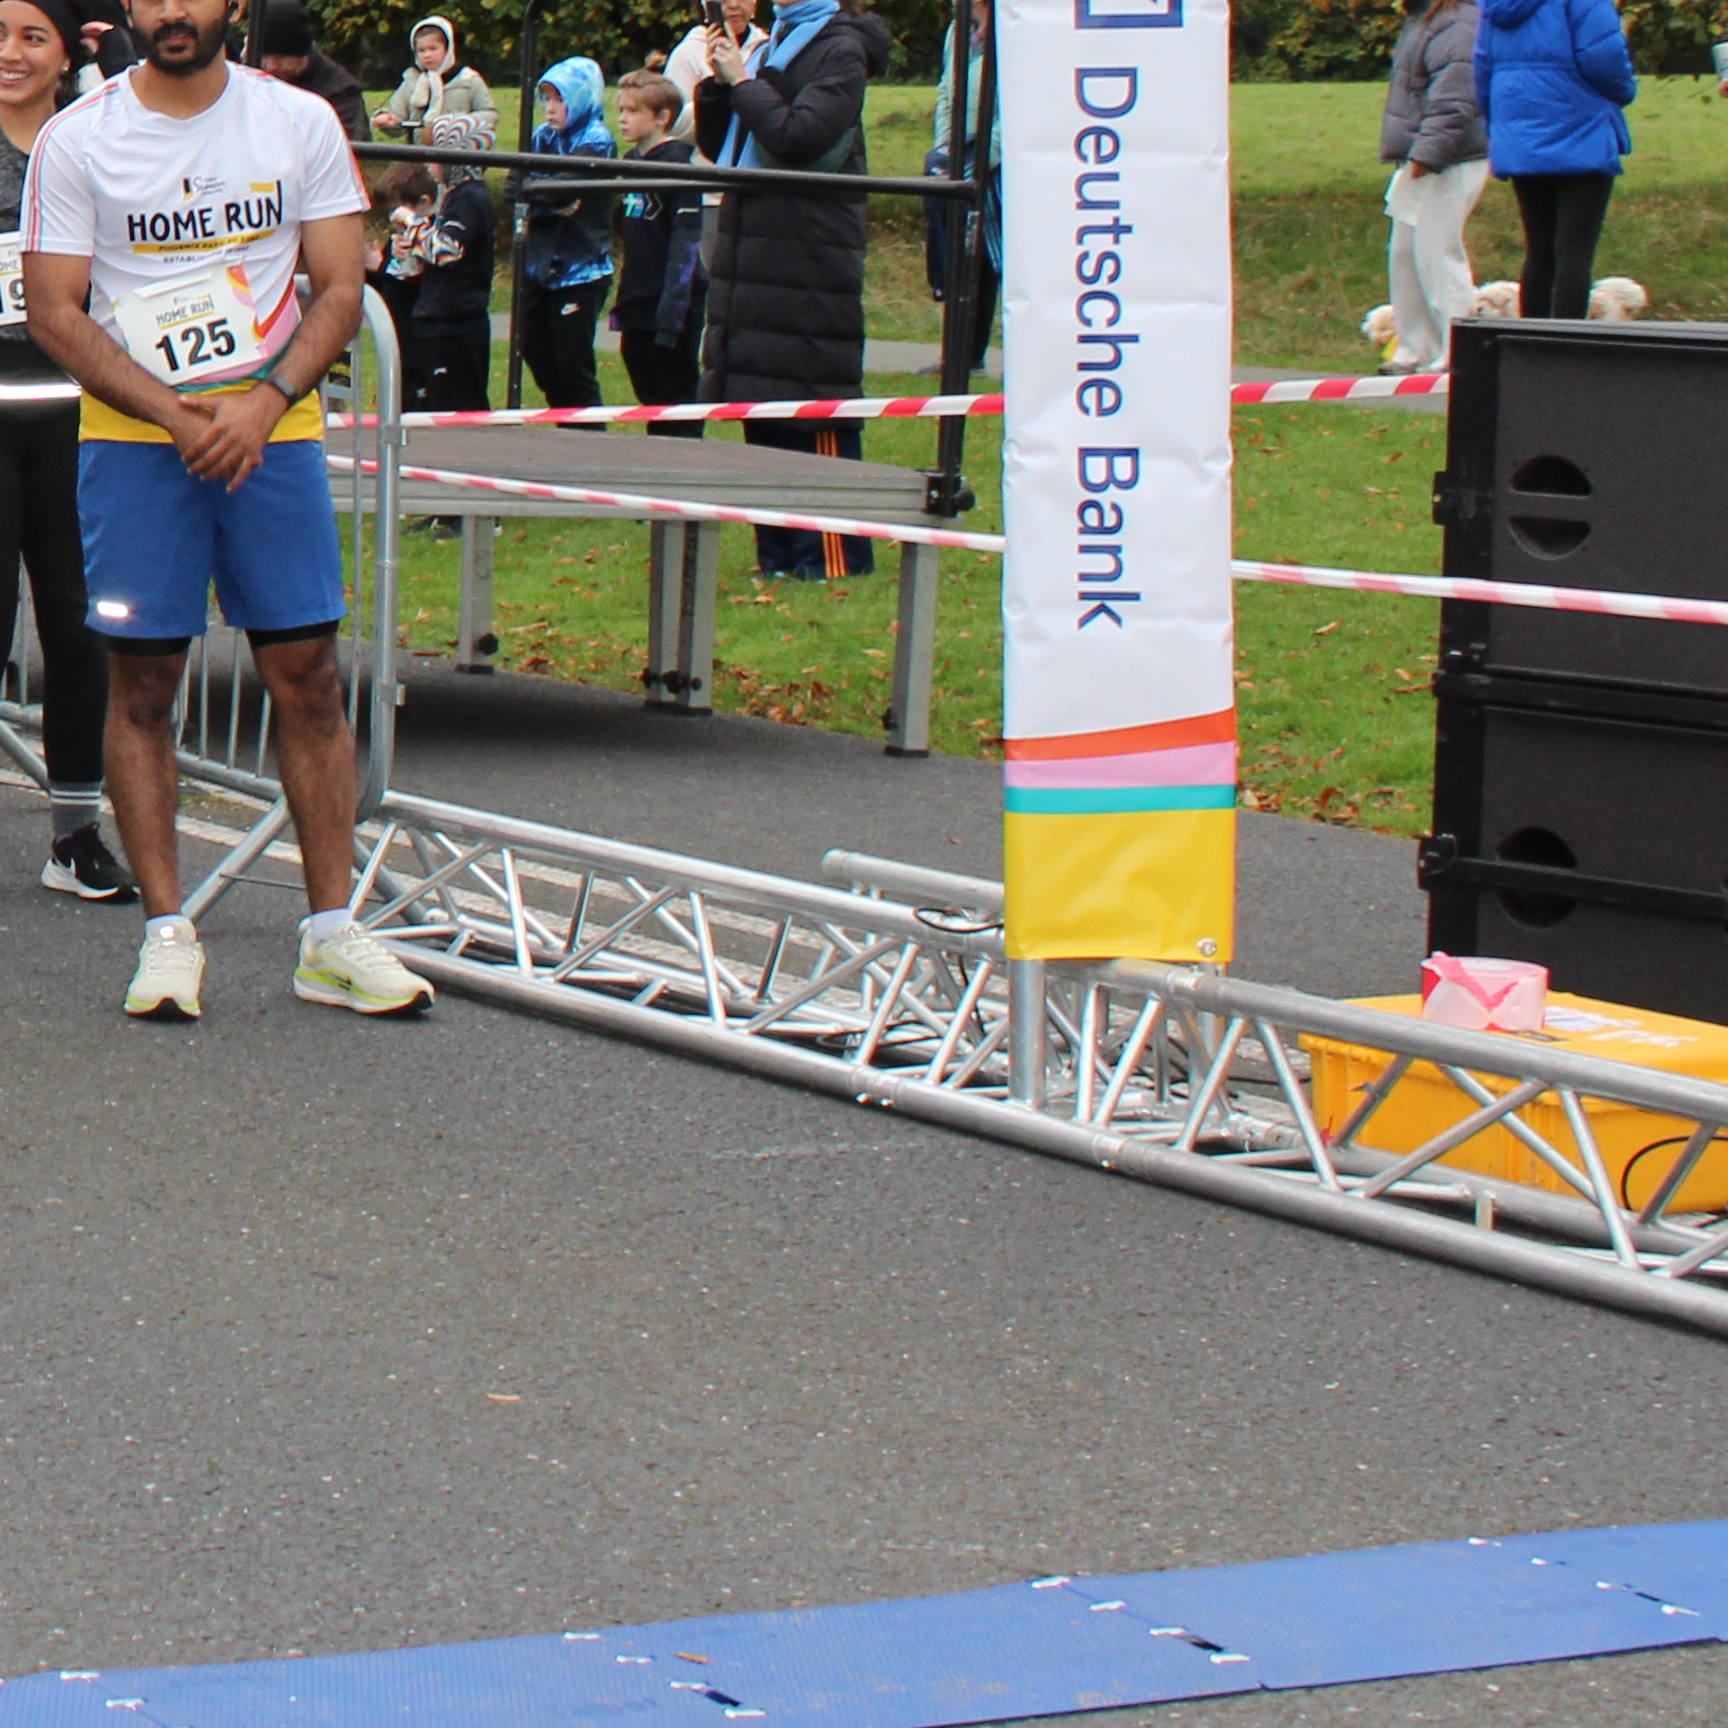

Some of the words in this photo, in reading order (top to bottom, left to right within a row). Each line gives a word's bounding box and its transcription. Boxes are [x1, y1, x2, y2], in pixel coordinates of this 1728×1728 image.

[127, 206, 215, 242] HOME
[224, 180, 282, 232] RUN
[1073, 67, 1141, 418] Deutsche
[156, 307, 189, 326] HOME
[190, 293, 214, 315] RUN
[155, 317, 236, 372] 125
[1077, 445, 1142, 630] Bank
